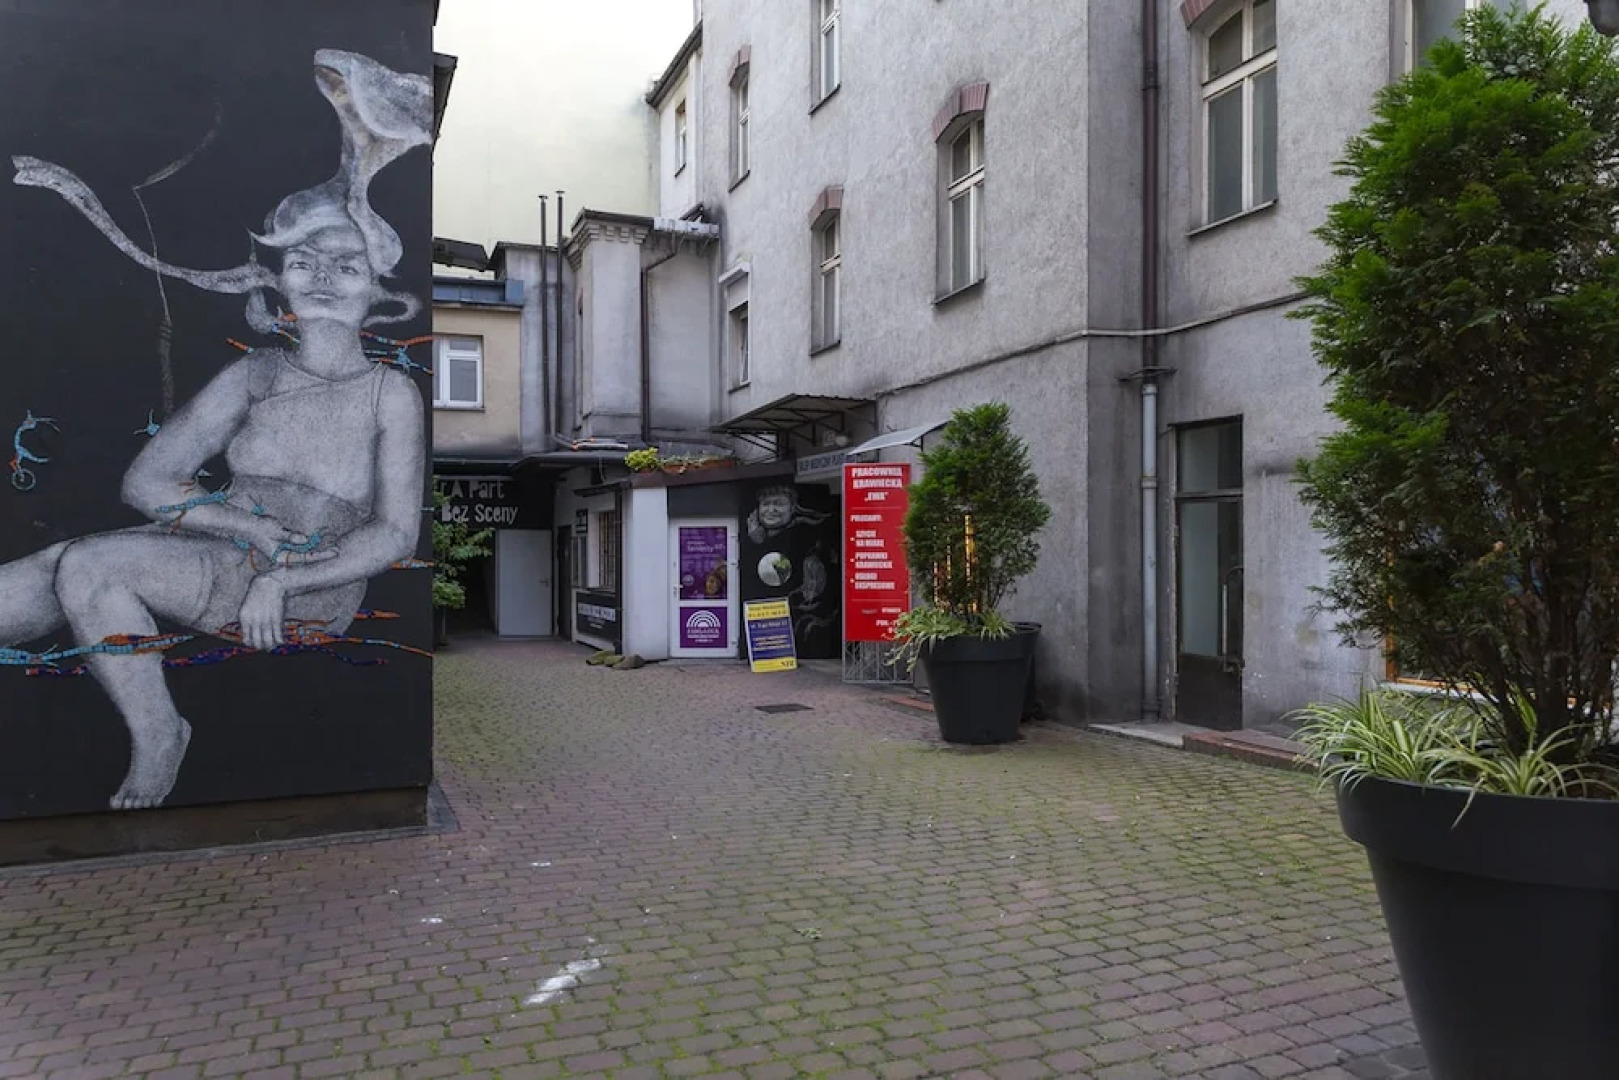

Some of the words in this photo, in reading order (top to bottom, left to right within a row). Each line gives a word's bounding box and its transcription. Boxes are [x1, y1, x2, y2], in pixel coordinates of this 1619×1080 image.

[851, 467, 903, 477] PRACOWNIA
[451, 479, 464, 498] A
[469, 479, 506, 499] Part
[852, 478, 903, 490] KRAWIECKA
[441, 502, 470, 523] Bez
[475, 503, 519, 526] Sceny
